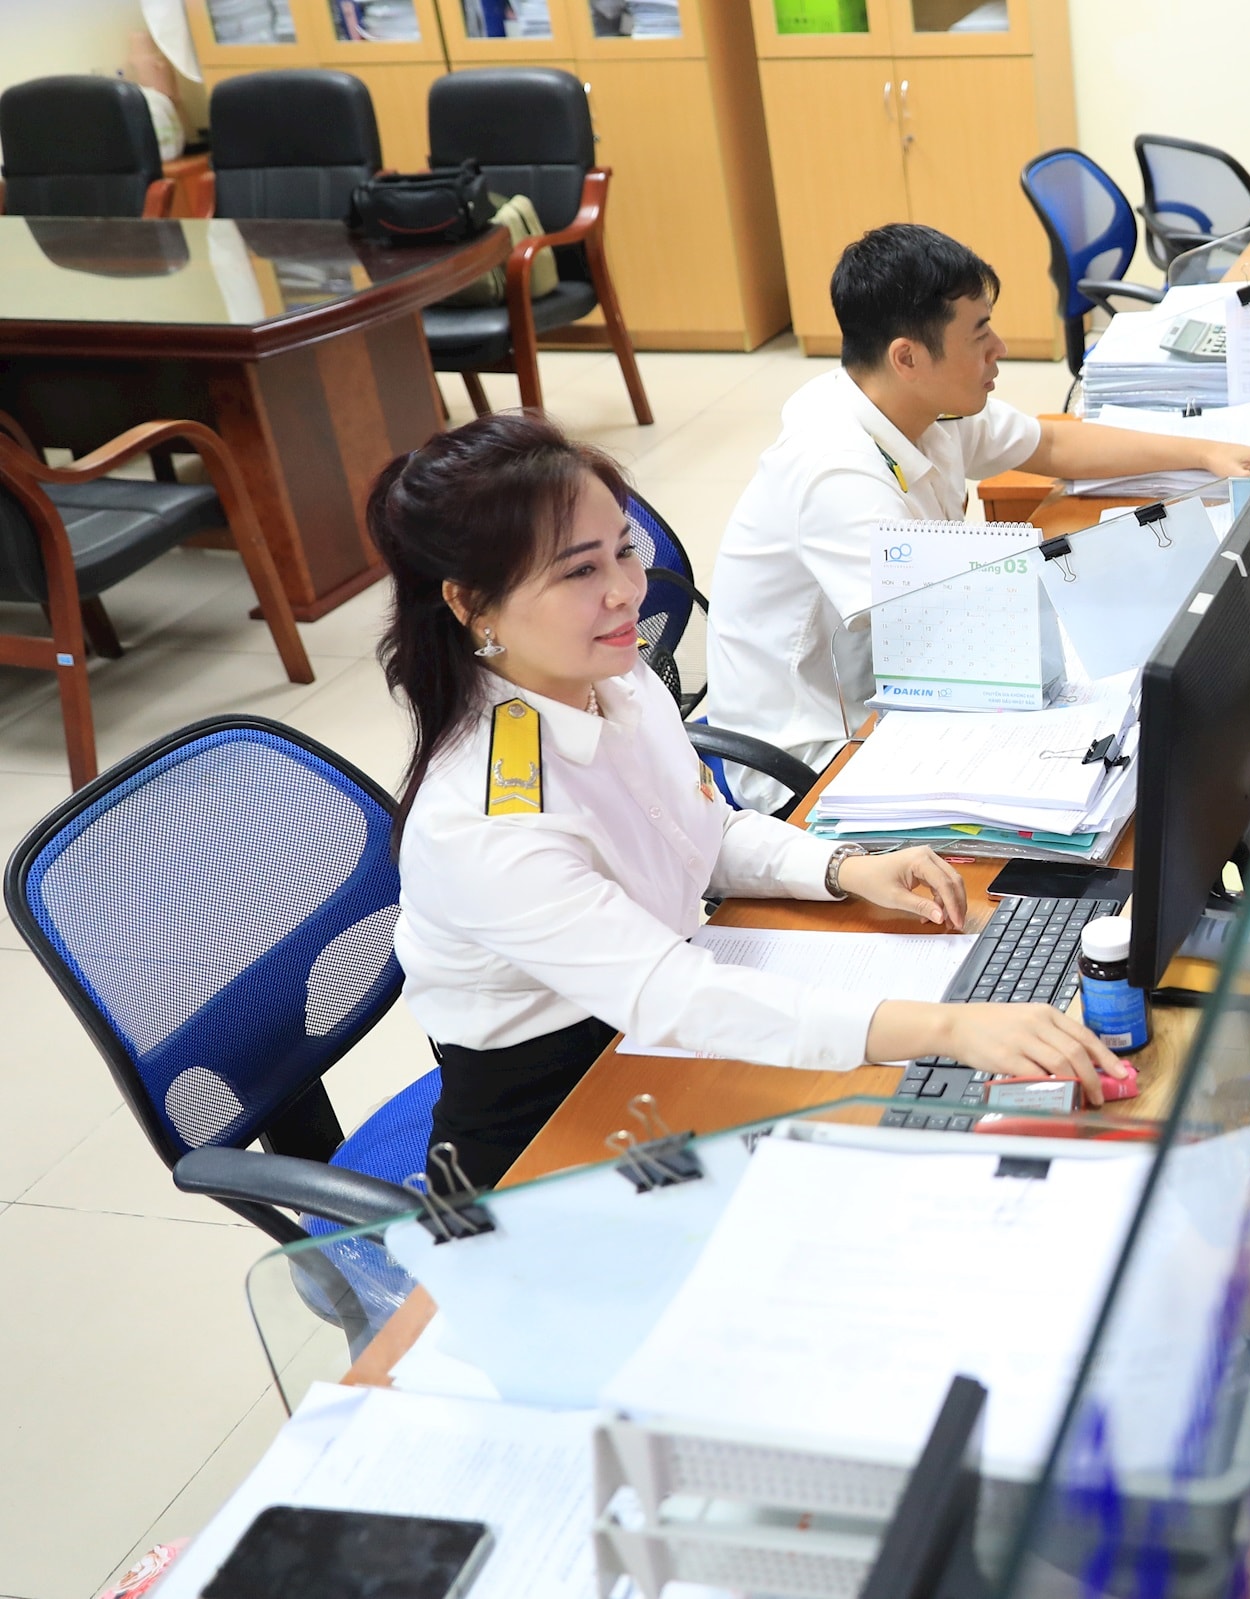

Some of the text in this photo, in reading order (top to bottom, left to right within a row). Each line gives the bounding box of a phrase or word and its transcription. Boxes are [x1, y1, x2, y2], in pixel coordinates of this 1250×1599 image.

[969, 559, 1028, 574] Tháng 03
[893, 688, 933, 697] DAIKIN
